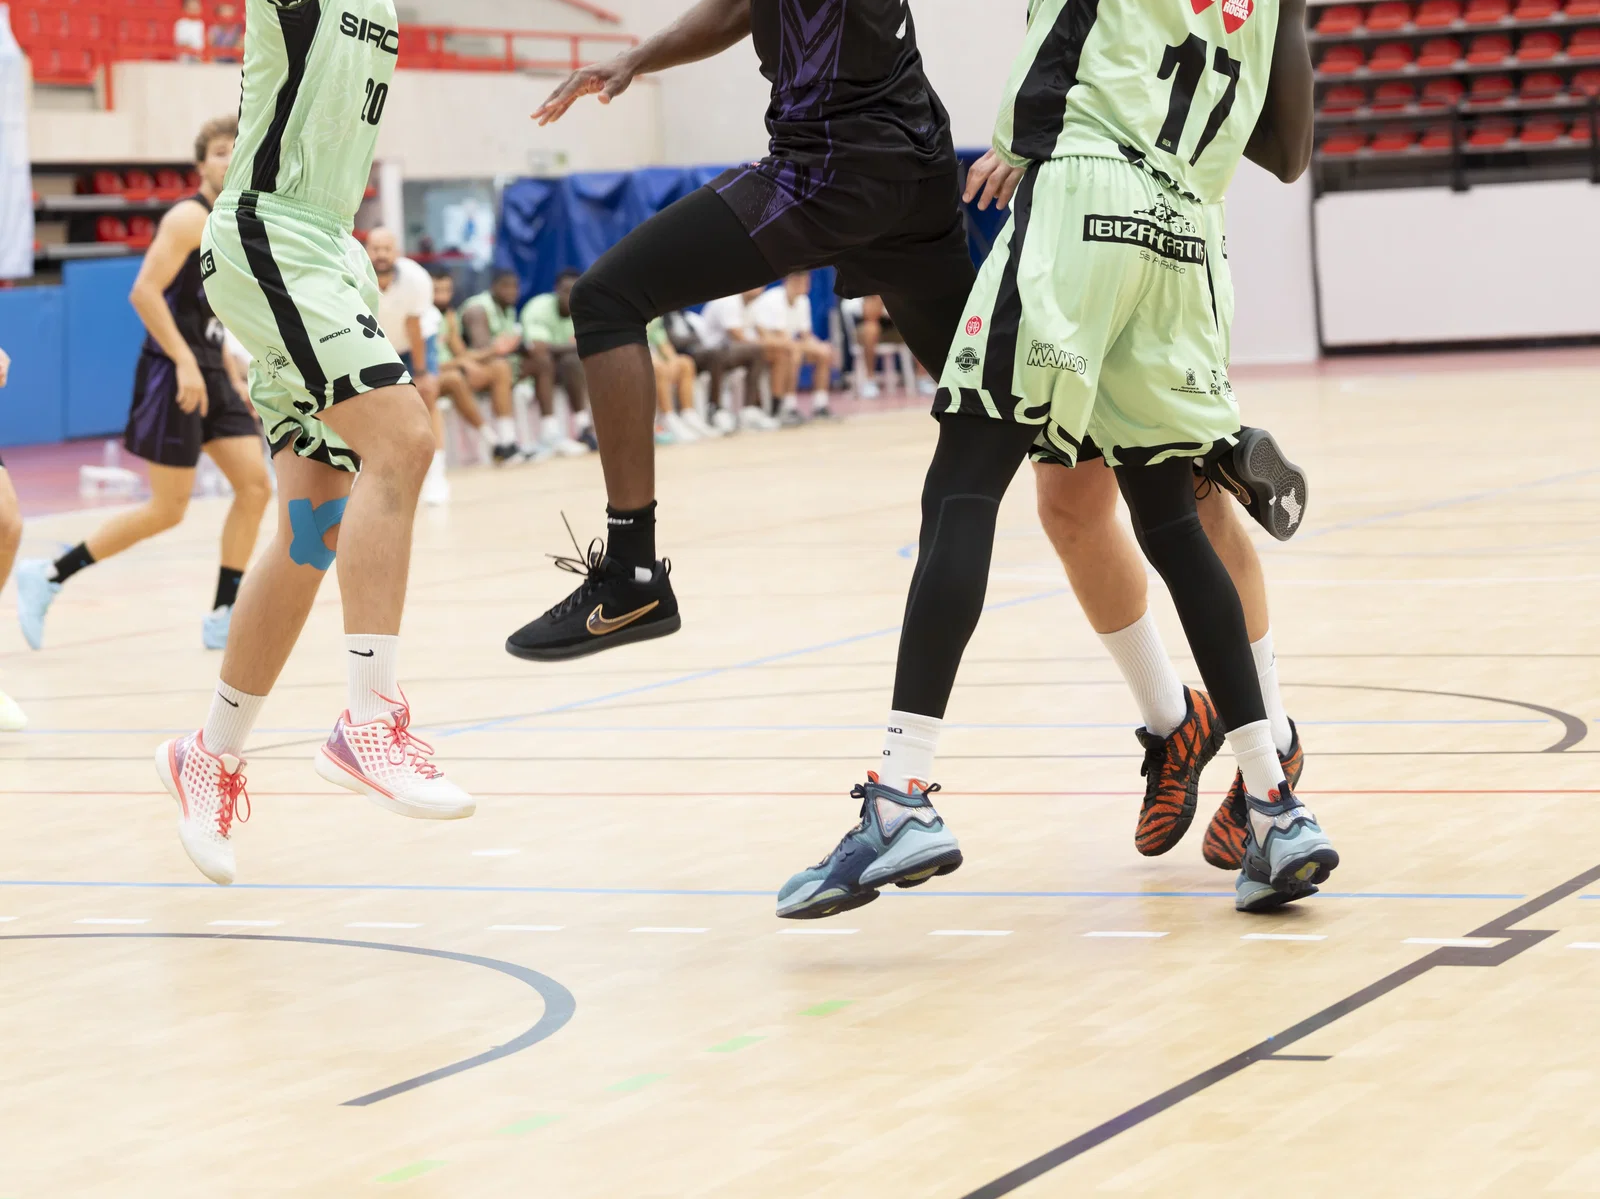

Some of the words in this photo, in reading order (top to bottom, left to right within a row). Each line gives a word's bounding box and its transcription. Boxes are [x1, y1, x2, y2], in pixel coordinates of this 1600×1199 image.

[1223, 1, 1249, 21] ROCKS
[361, 78, 388, 125] 20
[1155, 32, 1241, 167] 17
[319, 328, 351, 343] SIROKO
[1031, 340, 1054, 350] Grupo
[1027, 347, 1086, 375] MAMBO
